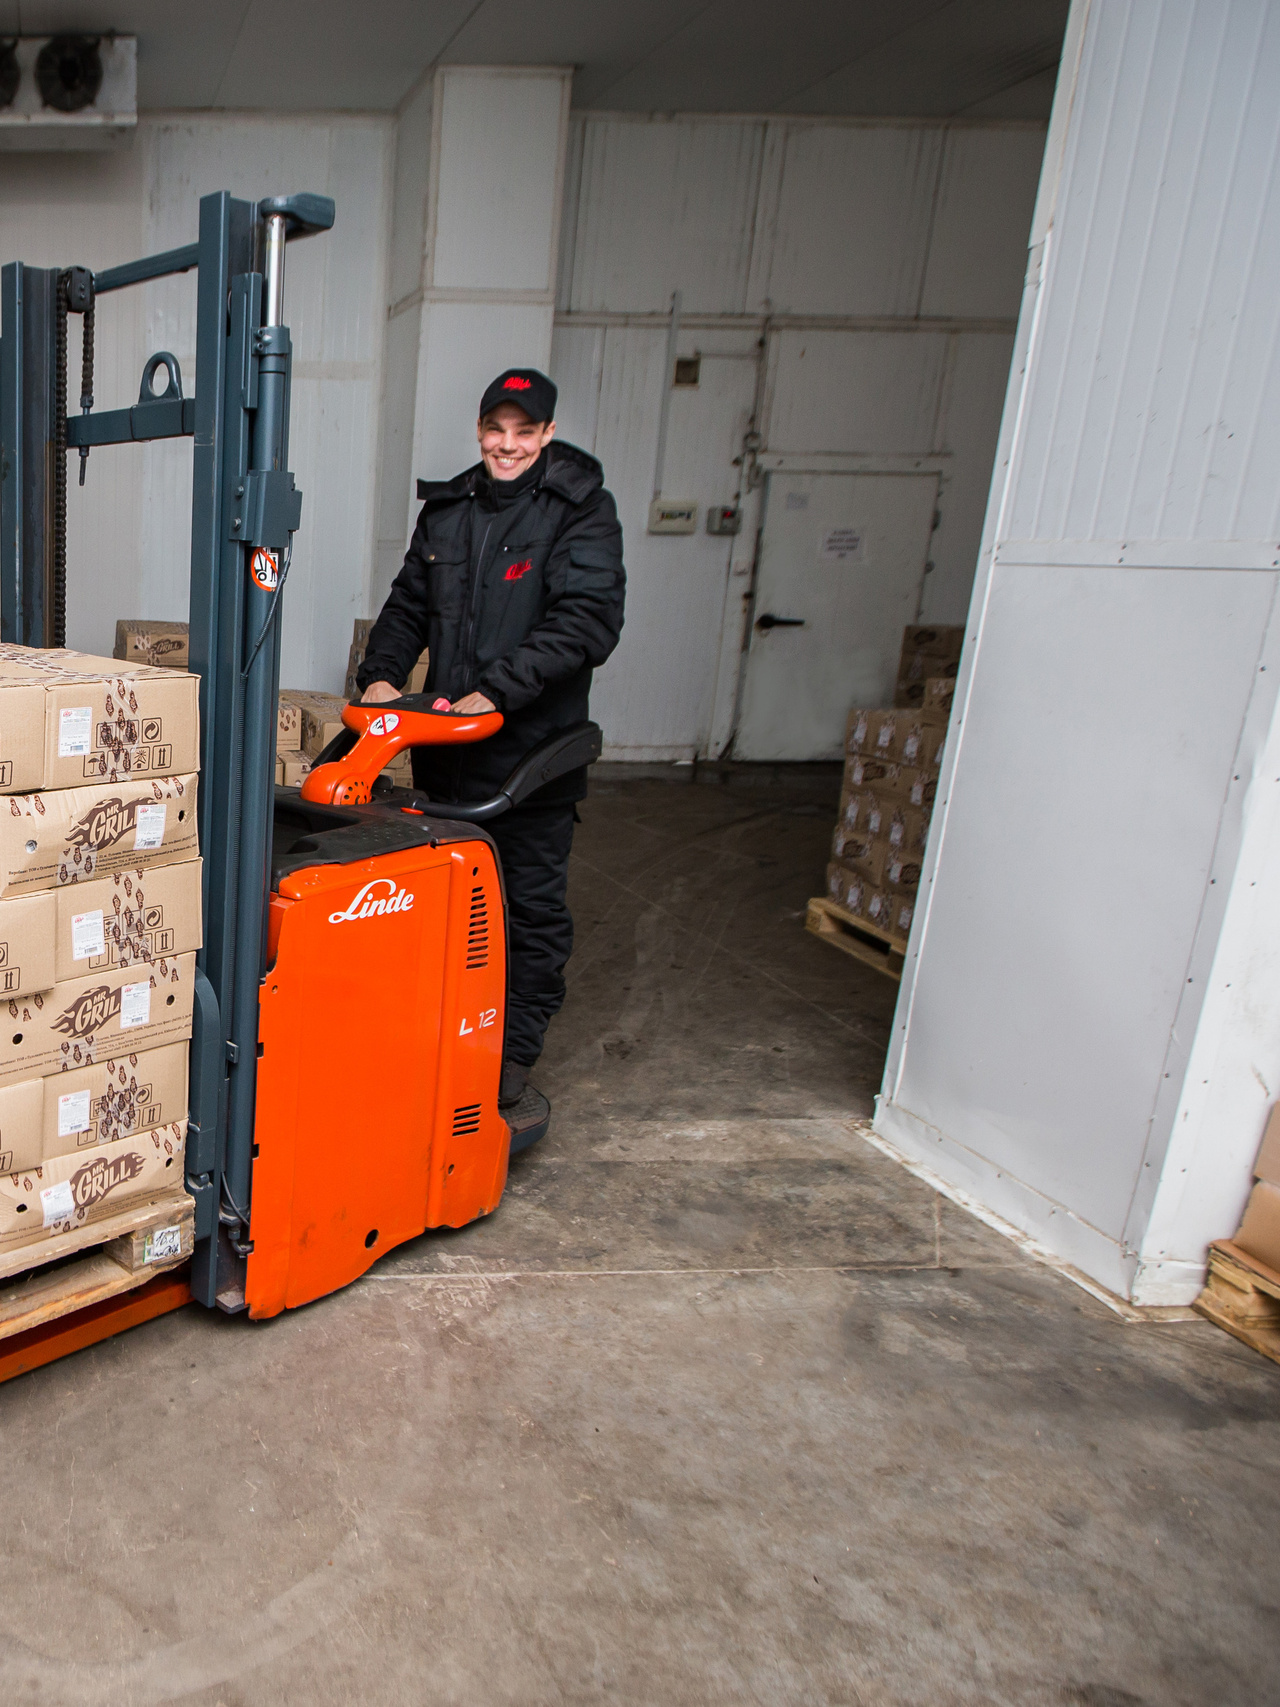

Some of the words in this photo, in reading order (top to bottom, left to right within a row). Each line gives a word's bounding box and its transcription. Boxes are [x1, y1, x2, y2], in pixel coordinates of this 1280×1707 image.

[106, 803, 119, 818] MR
[328, 879, 415, 924] Linde
[93, 990, 106, 1005] MR
[75, 995, 120, 1033] GRIL
[459, 1018, 473, 1036] L
[478, 1008, 497, 1030] 12
[76, 1161, 131, 1206] GRILL
[92, 1162, 105, 1177] MR
